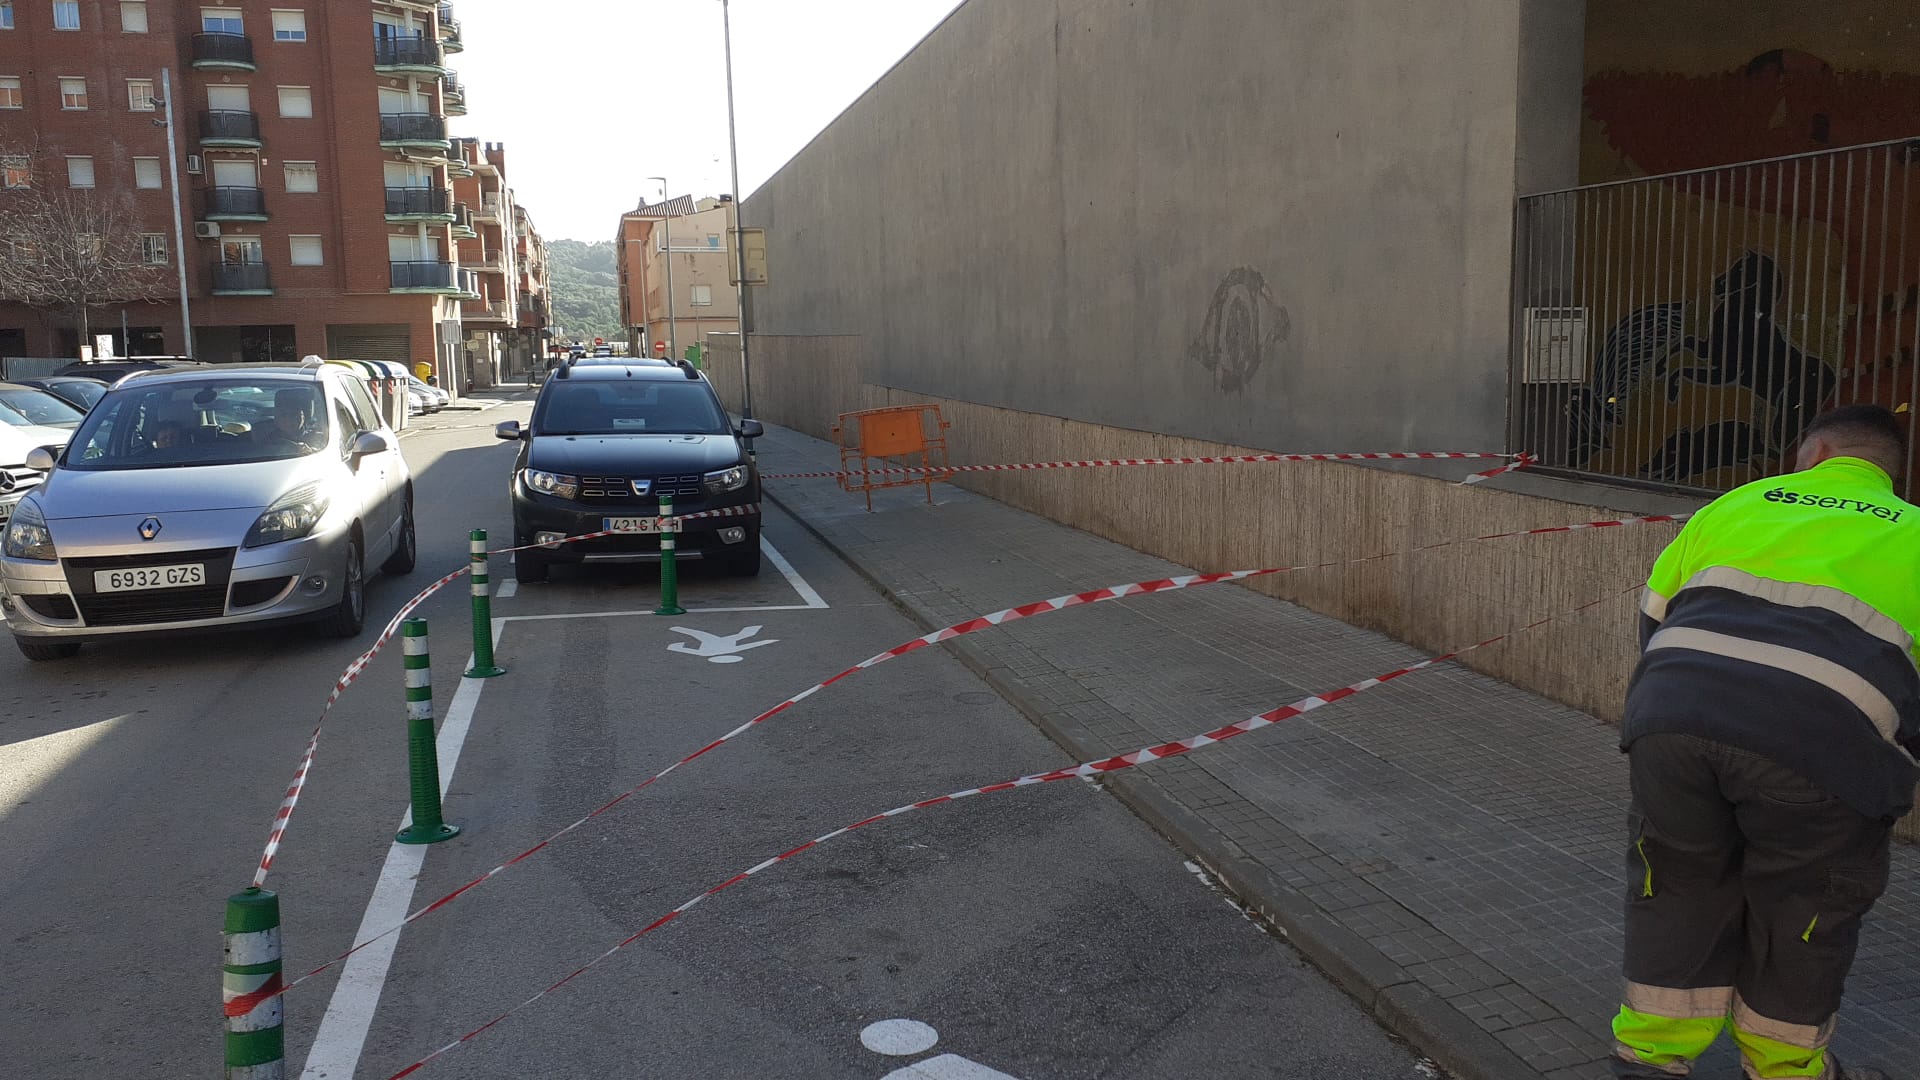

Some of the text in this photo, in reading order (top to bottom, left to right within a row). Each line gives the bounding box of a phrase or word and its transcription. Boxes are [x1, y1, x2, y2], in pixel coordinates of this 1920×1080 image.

[653, 519, 679, 532] KH
[111, 567, 200, 588] 6932 GZS
